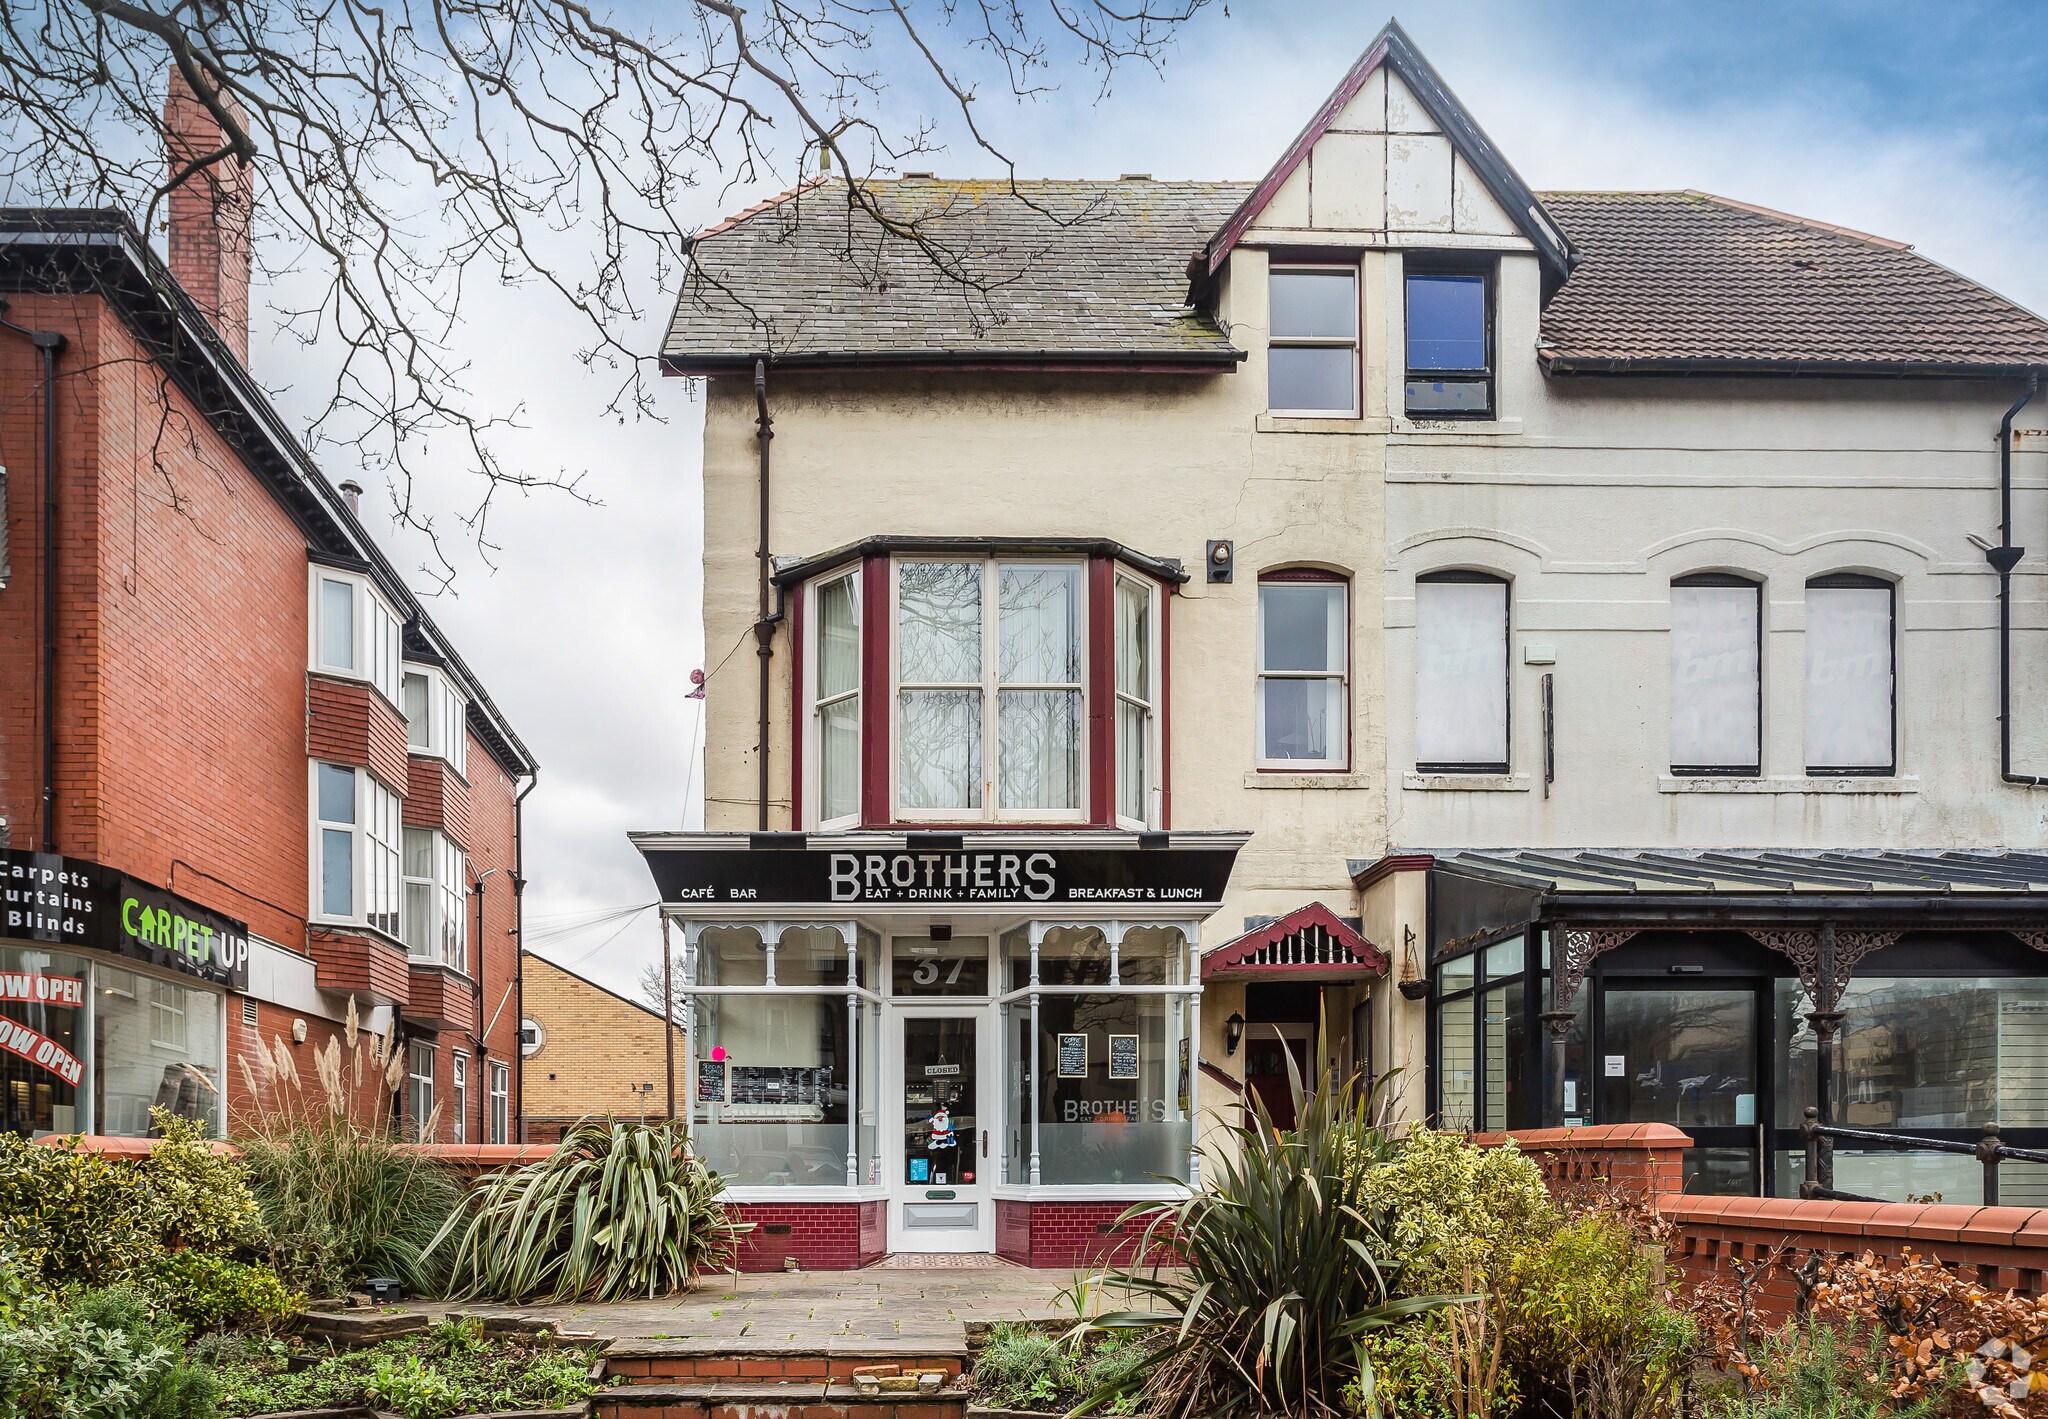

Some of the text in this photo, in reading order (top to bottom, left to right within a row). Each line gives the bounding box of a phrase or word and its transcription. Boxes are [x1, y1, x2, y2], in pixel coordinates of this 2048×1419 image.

[828, 853, 1056, 901] BROTHERS
[0, 885, 93, 913] urtains
[681, 885, 757, 899] CAFÉ BAR
[865, 888, 892, 899] EAT
[908, 888, 953, 899] DRINK
[969, 888, 1020, 899] FAMILY
[1068, 888, 1203, 899] BREAKFAST & LUNCH
[8, 910, 85, 935] Blinds
[122, 897, 248, 972] CARPET UP
[912, 952, 967, 985] 37
[36, 976, 83, 1004] OPEN
[36, 1040, 83, 1084] OPEN
[926, 1067, 959, 1075] CLOSED
[1063, 1099, 1167, 1122] BROTHERS
